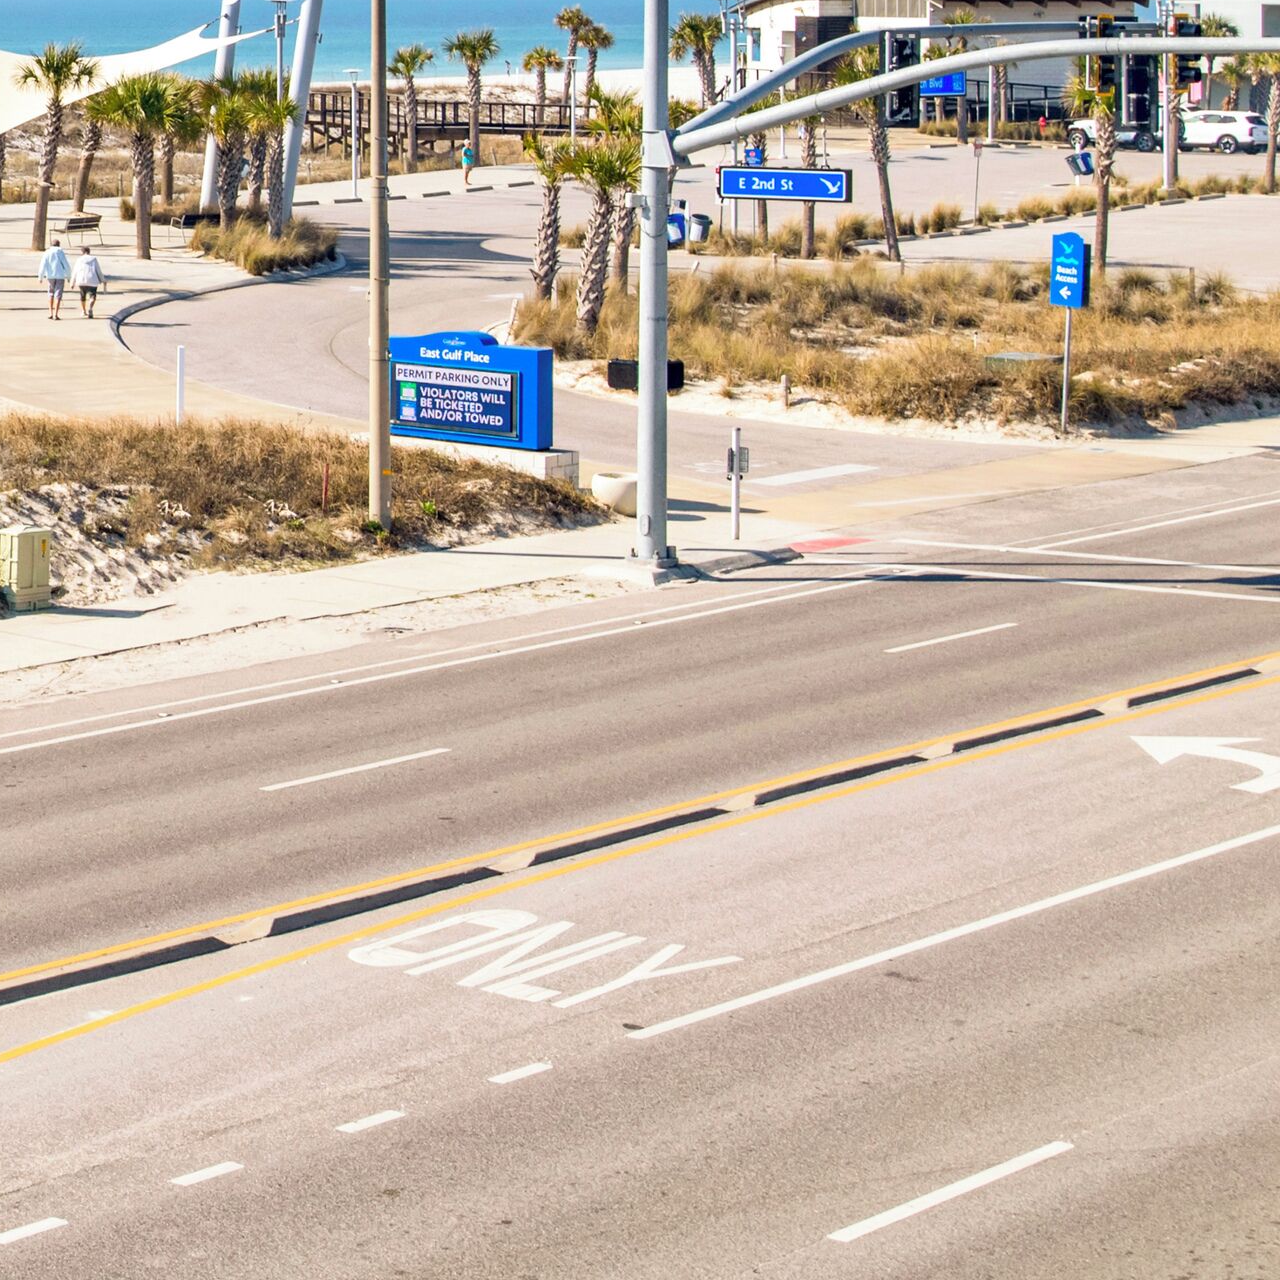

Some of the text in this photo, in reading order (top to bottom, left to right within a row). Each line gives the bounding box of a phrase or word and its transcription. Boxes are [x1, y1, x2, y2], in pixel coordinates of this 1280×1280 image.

[739, 177, 793, 190] E 2nd St
[1056, 265, 1078, 275] Beach
[1055, 273, 1078, 284] Access
[420, 347, 490, 363] East Gulf Place
[397, 367, 509, 387] PERMIT PARKING ONLY
[420, 386, 505, 404] VIOLATORS WILL
[420, 397, 483, 413] BE TICKETED
[420, 408, 503, 426] AND/OR TOWED
[348, 909, 743, 1008] ONLY
